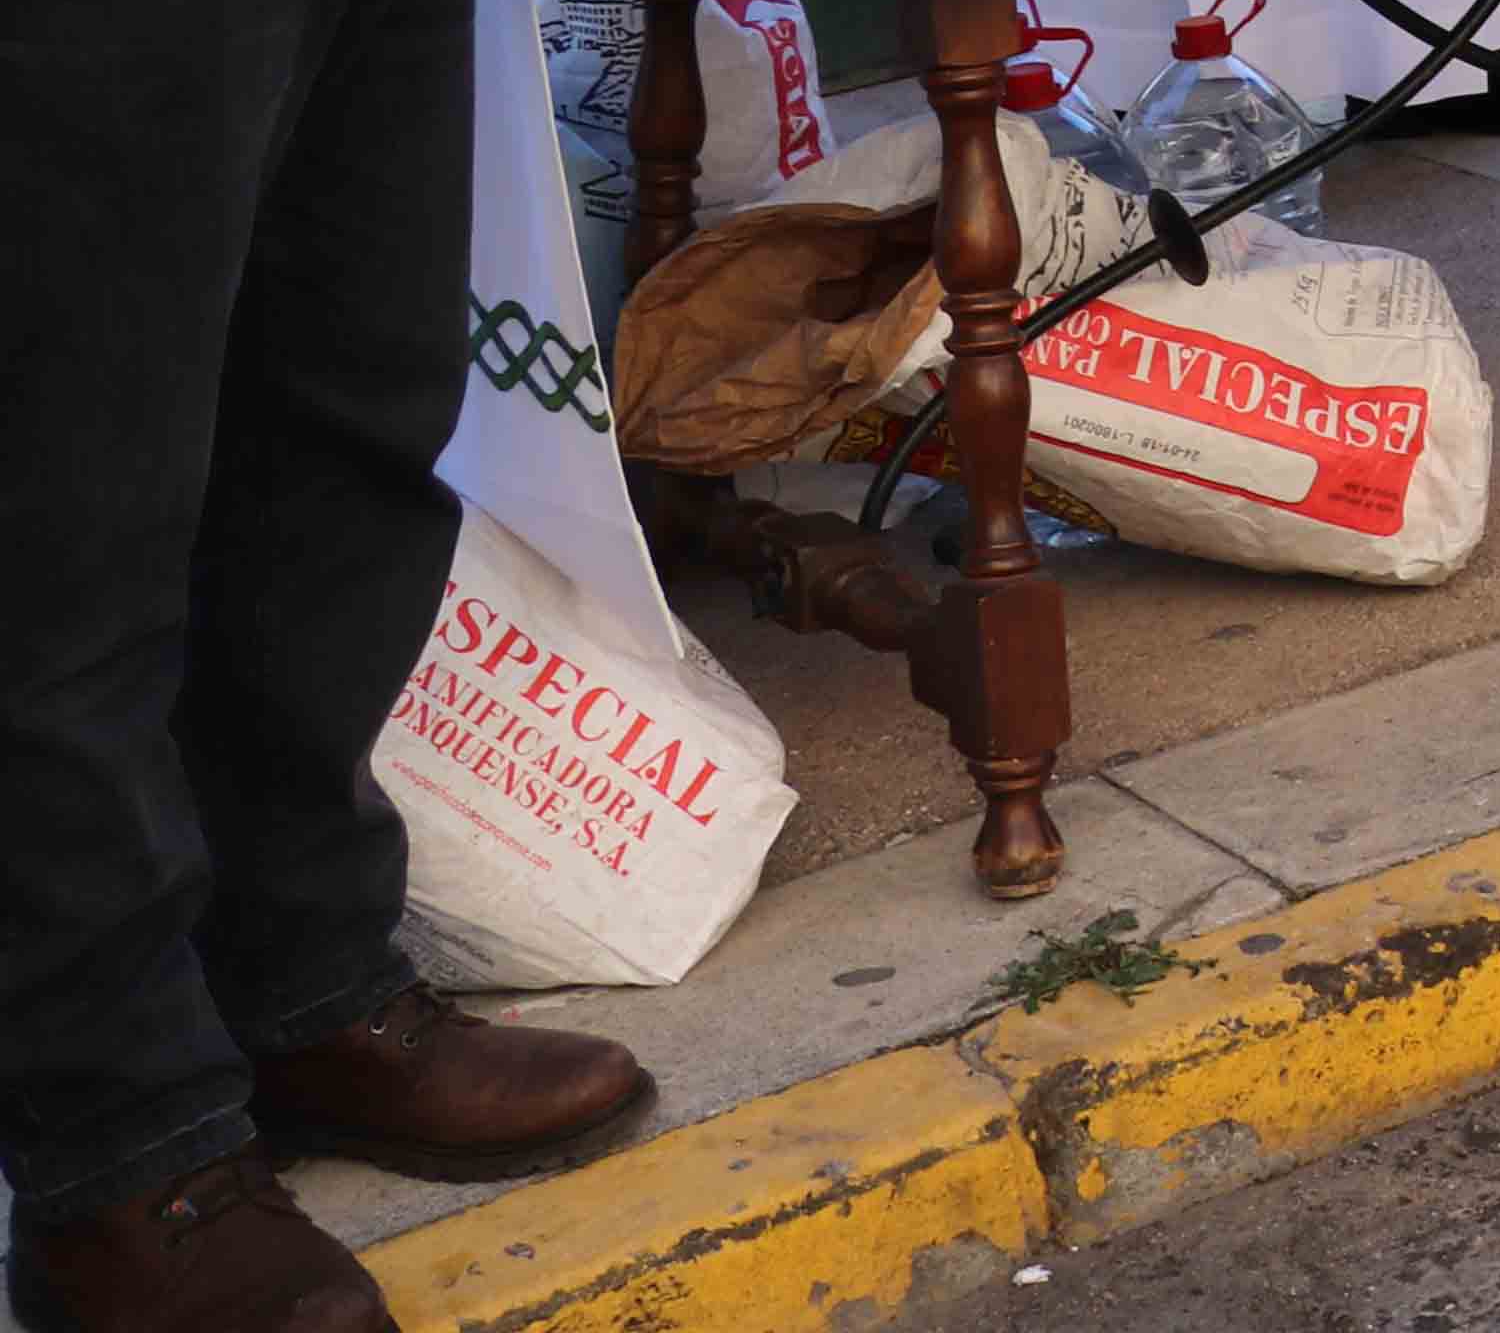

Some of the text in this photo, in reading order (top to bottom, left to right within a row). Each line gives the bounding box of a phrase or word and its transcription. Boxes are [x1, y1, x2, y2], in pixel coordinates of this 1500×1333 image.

[1025, 326, 1421, 454] ESPECIAL PAN
[389, 689, 630, 878] ONQUENSE, S.A.
[406, 661, 654, 842] ANIFICADORA
[436, 581, 724, 827] SPECIAL
